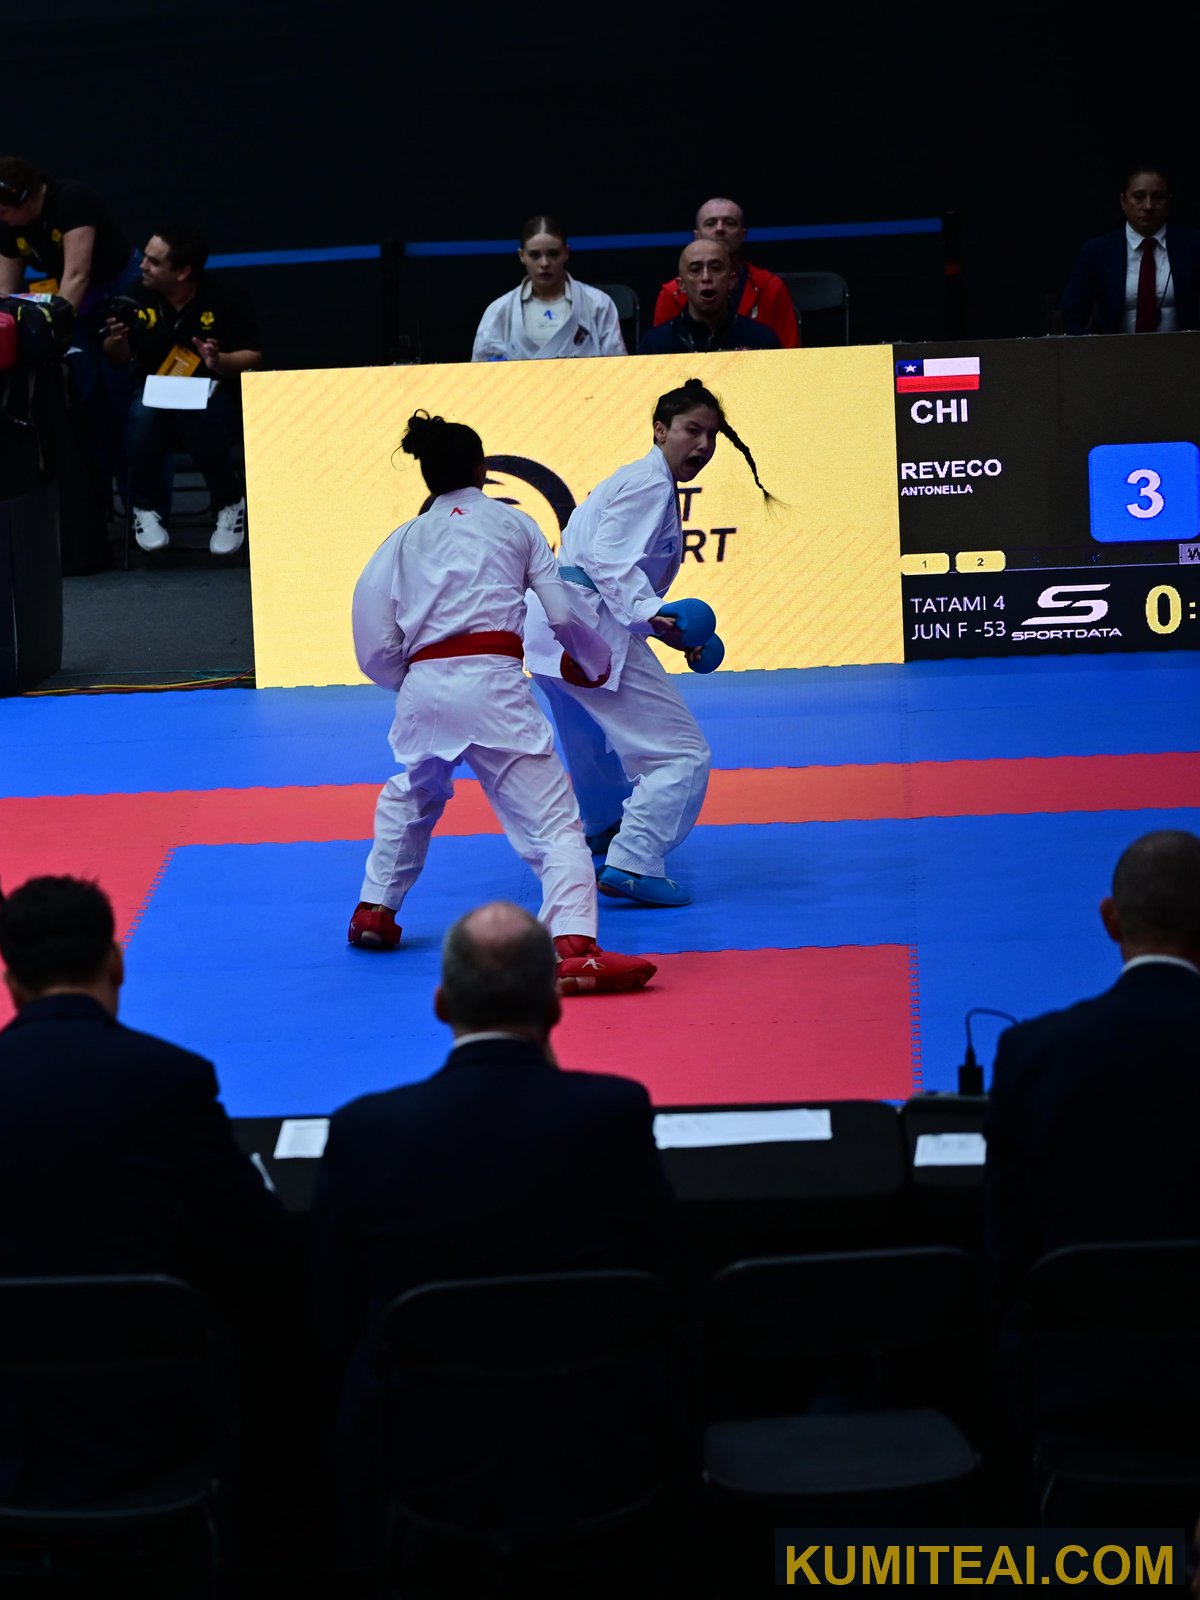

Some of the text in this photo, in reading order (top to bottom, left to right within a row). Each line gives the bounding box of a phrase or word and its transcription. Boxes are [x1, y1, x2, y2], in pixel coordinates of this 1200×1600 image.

[910, 398, 968, 424] CHI
[901, 459, 1002, 480] REVECO
[901, 484, 973, 496] ANTONELLA
[1126, 468, 1165, 519] 3
[677, 487, 702, 522] T
[681, 528, 736, 563] RT
[977, 558, 984, 566] 2
[910, 595, 1005, 613] TATAMI 4
[911, 621, 1006, 640] JUN F -53
[1011, 627, 1122, 641] SPORTDATA
